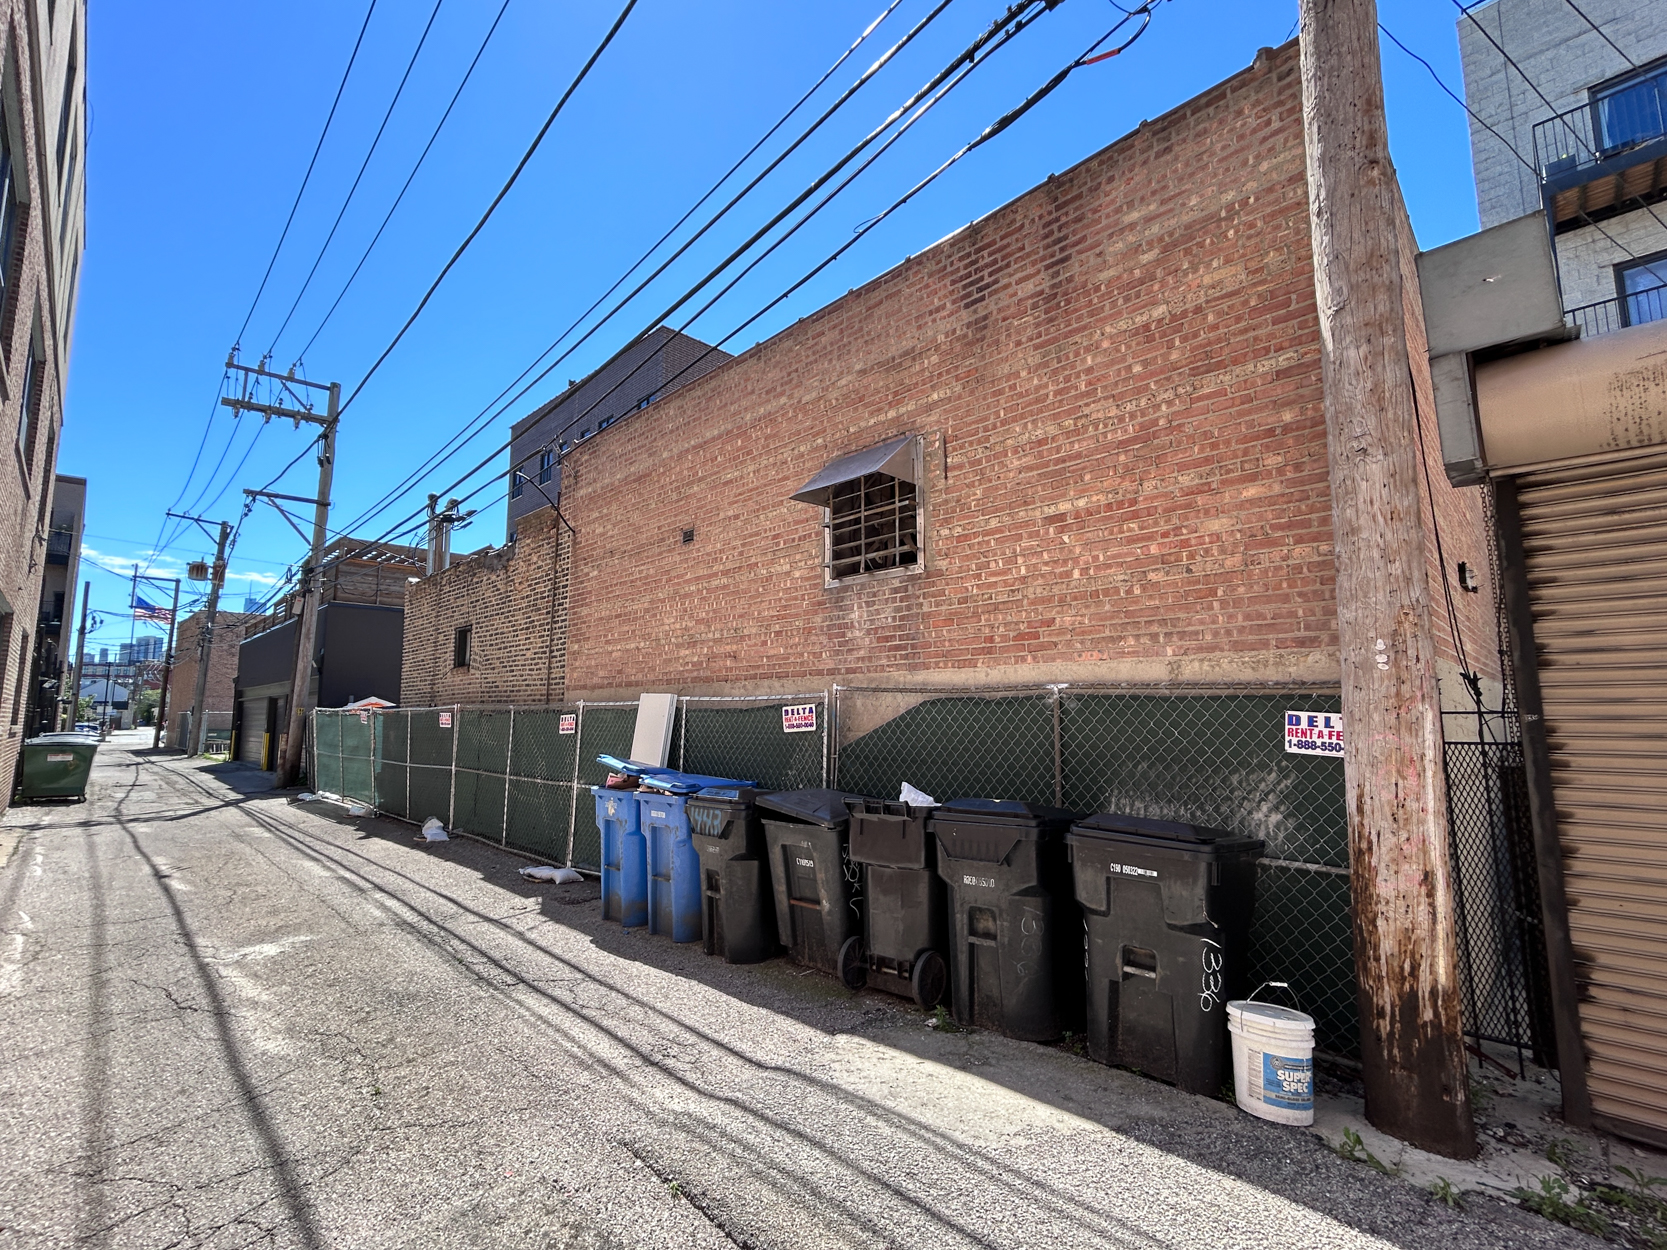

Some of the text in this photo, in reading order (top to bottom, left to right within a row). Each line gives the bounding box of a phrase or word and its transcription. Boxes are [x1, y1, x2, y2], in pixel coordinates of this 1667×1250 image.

[784, 707, 814, 716] DELTA
[784, 715, 814, 723] RENT-A-FENCE
[1287, 714, 1343, 729] DEL
[1197, 938, 1223, 1012] 1336
[1276, 1069, 1312, 1083] SUPER
[1282, 1081, 1309, 1093] SPEC
